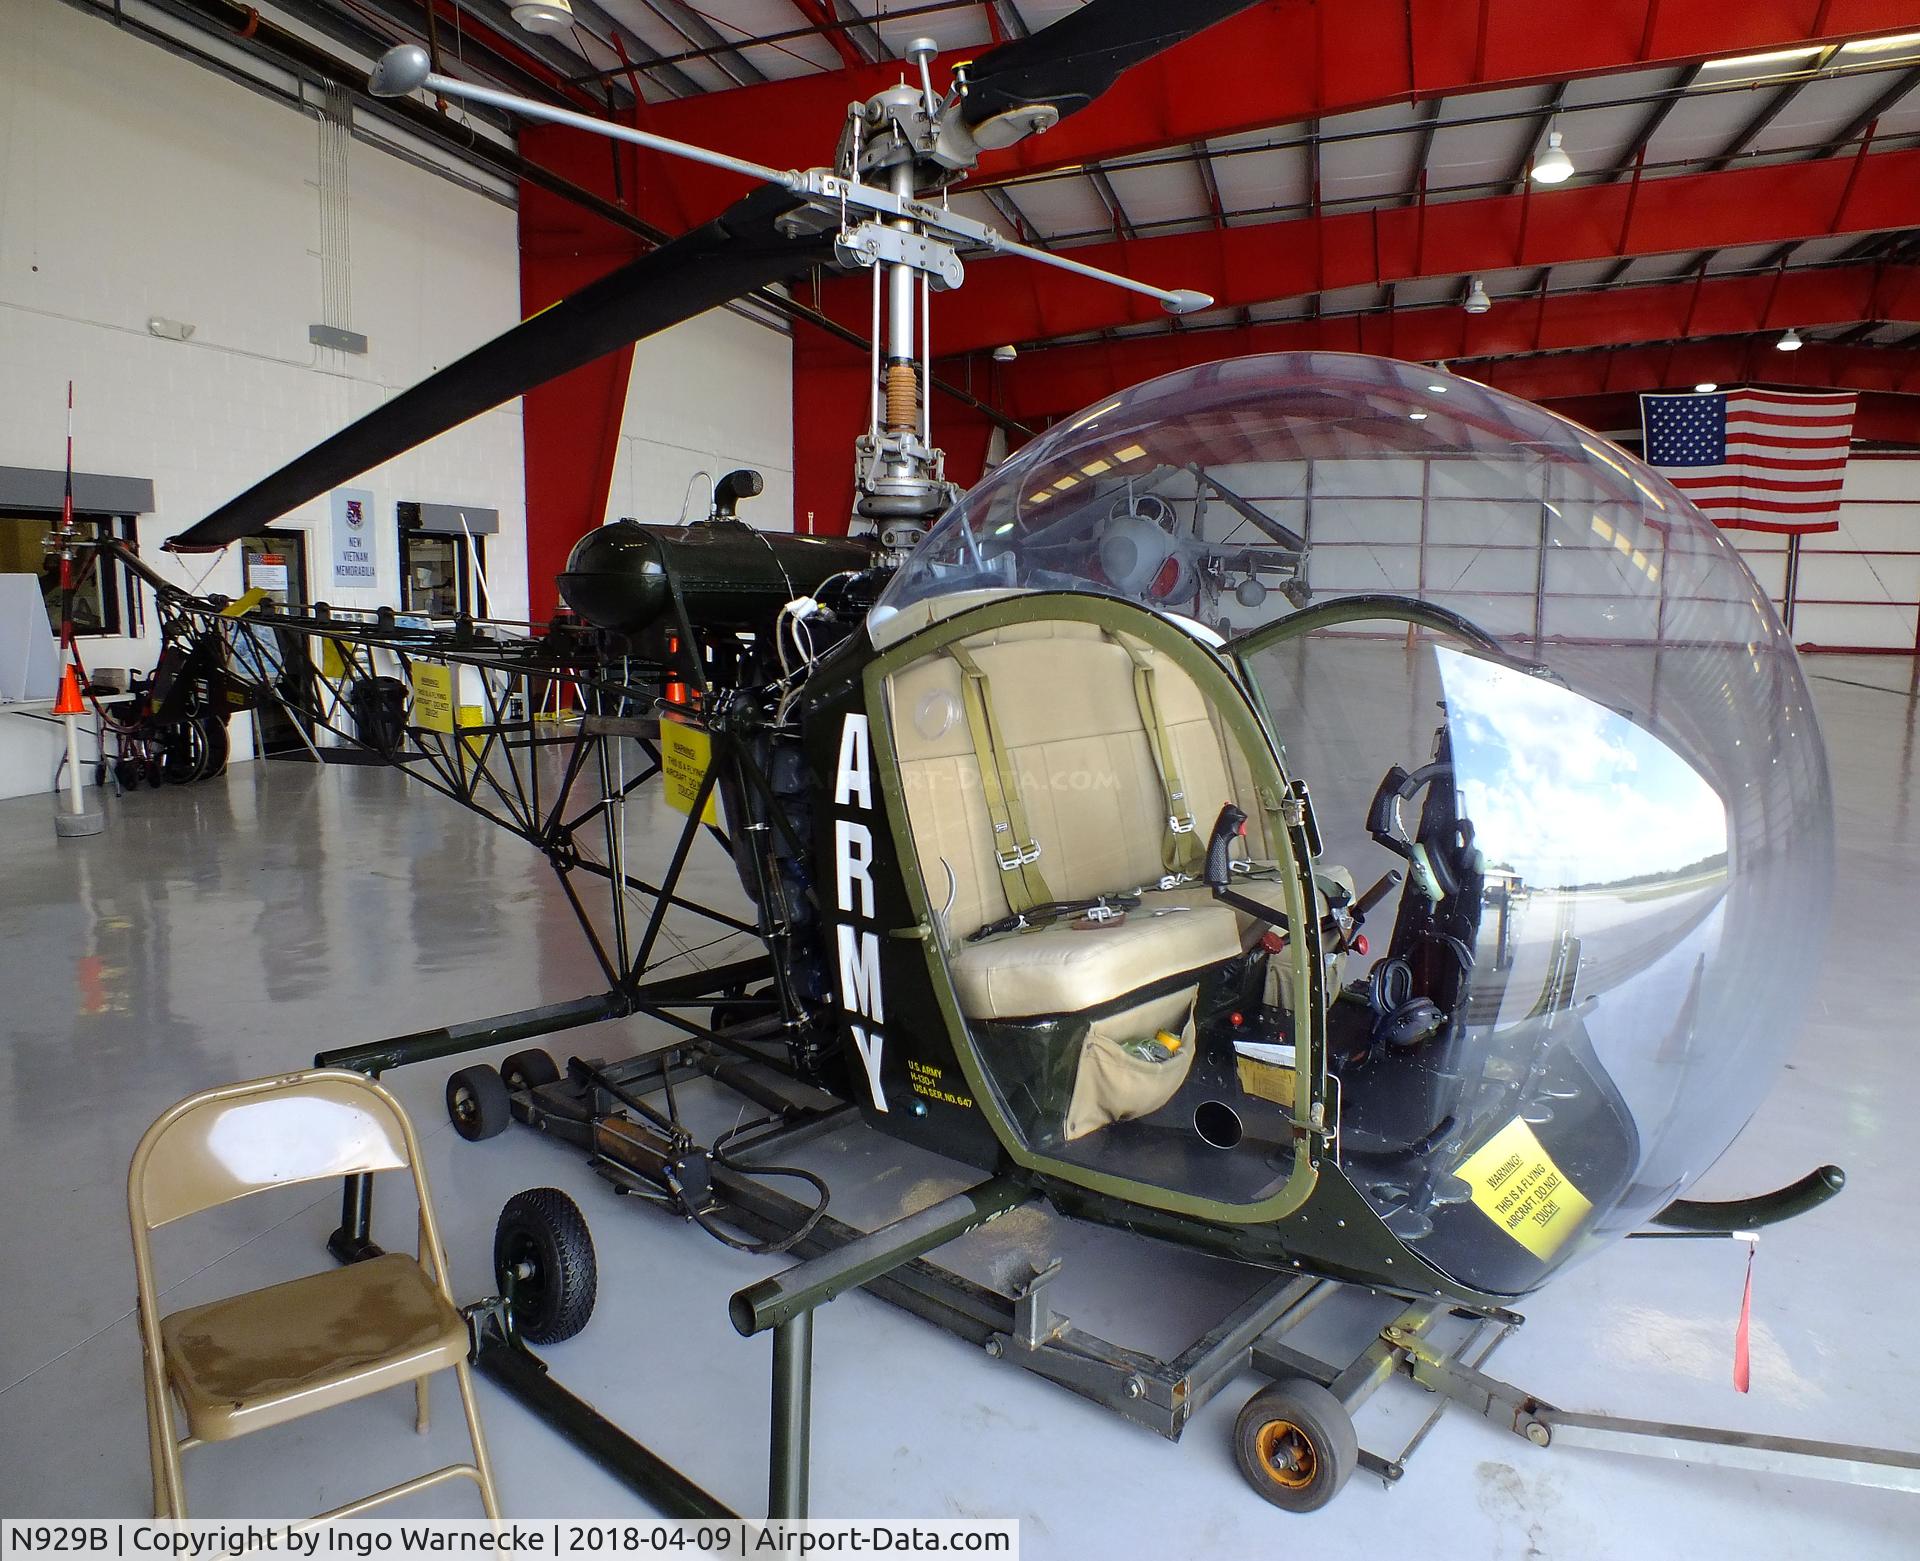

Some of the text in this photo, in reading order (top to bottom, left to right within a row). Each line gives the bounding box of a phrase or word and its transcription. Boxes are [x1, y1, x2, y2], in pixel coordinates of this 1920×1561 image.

[349, 537, 361, 547] NEW
[343, 551, 368, 562] VIETNAM
[336, 565, 375, 576] MEMORABILIA
[835, 713, 889, 1113] ARMY
[922, 1065, 942, 1079] ARMY
[913, 1083, 928, 1095] USA
[944, 1093, 957, 1104] NO.
[957, 1096, 972, 1108] 647
[1487, 1153, 1522, 1189] WARNING!
[1495, 1163, 1546, 1214] THIS IS A FLYING
[1534, 1186, 1547, 1200] DO
[1543, 1172, 1559, 1191] NOT
[1532, 1199, 1558, 1225] TOUCH!
